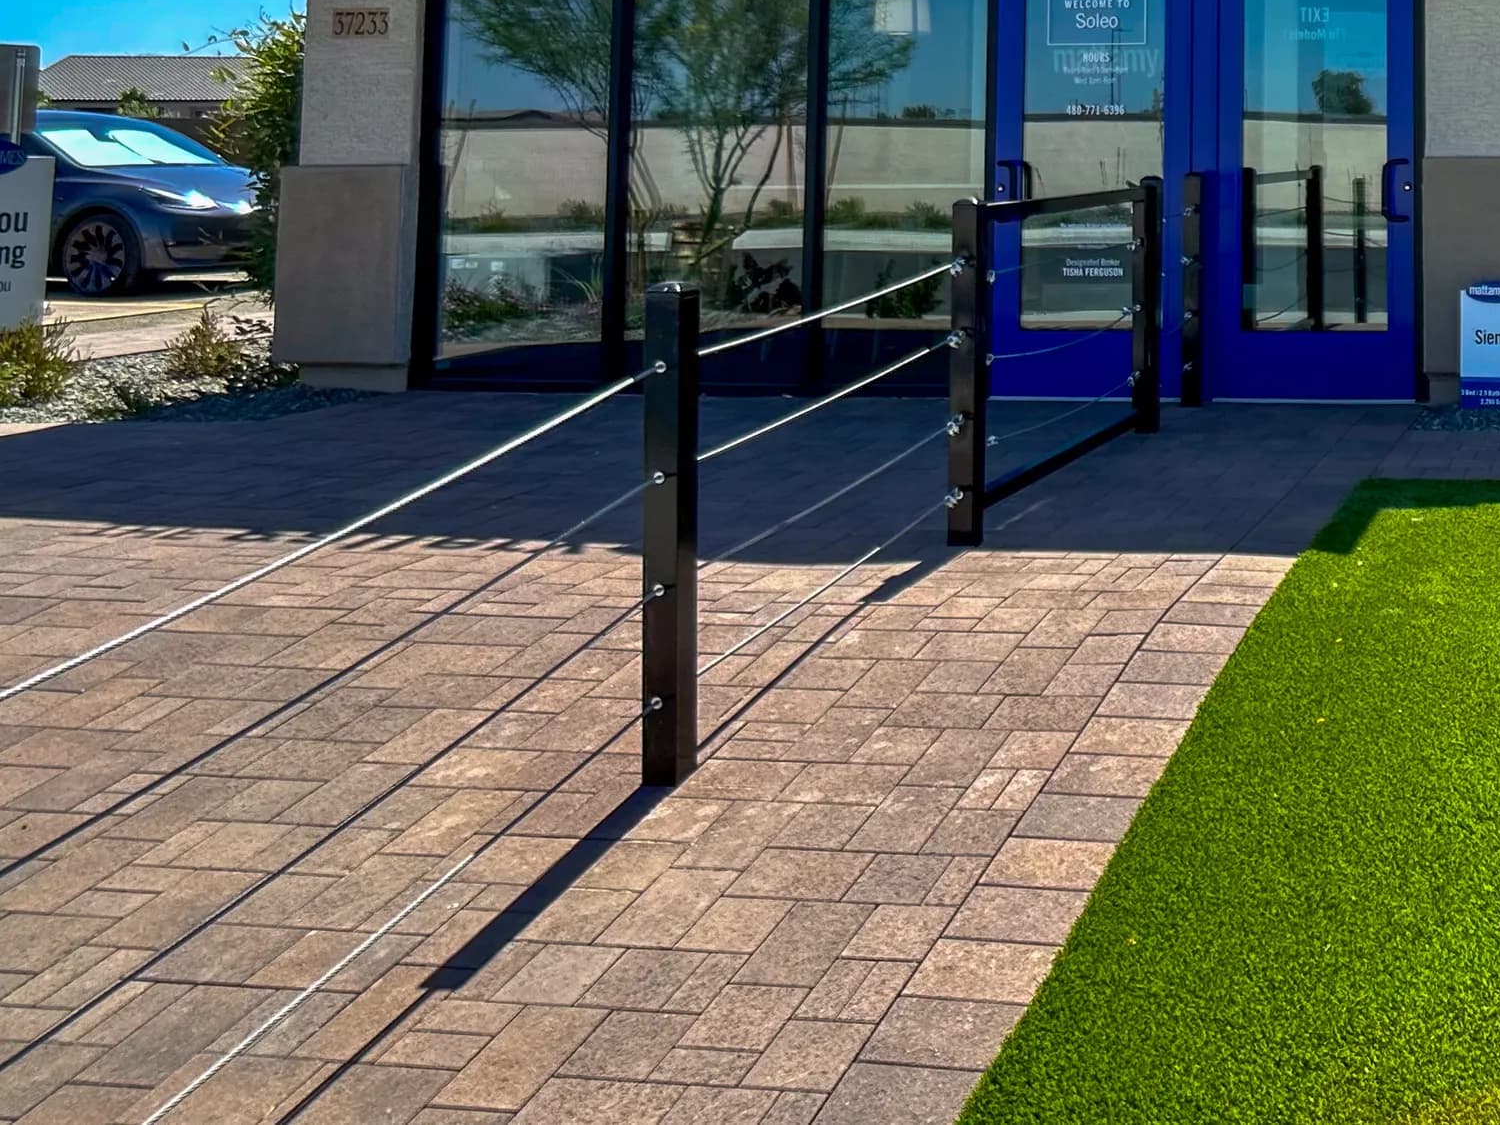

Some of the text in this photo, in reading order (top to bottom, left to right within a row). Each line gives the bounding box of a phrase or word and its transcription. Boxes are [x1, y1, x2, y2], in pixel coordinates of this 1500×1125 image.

[1064, 0, 1113, 8] WELCOME
[334, 11, 389, 35] 37233
[1075, 12, 1119, 29] Soleo
[1082, 52, 1111, 63] HOURS
[1066, 104, 1125, 115] 480-771-6396
[1062, 267, 1124, 277] TISHA FERGUSON
